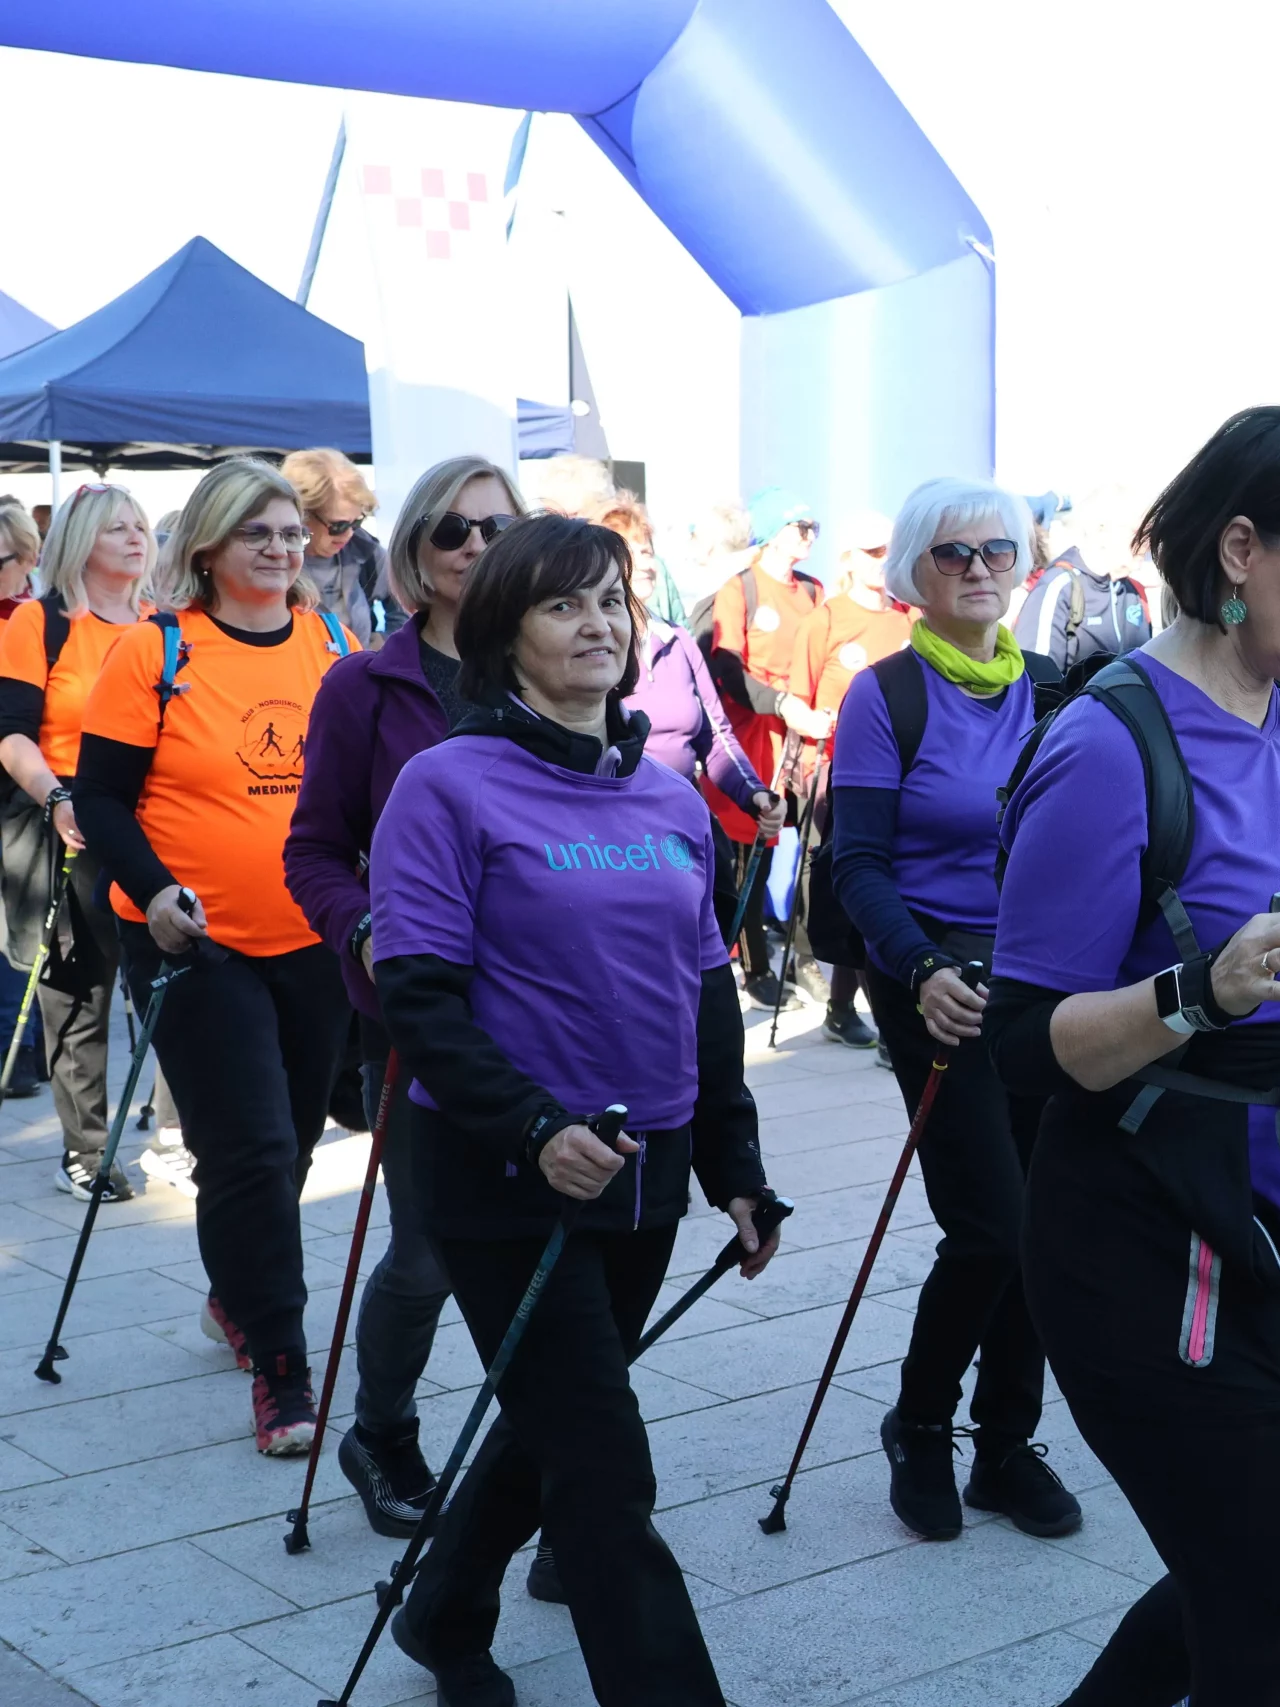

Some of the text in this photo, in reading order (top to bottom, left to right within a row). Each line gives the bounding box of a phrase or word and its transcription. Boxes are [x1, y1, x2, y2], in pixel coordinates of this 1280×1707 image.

[240, 708, 254, 724] KLUB
[248, 784, 302, 796] MEDIM
[543, 833, 661, 871] unicef
[375, 1083, 391, 1130] NEWFEEL
[516, 1269, 547, 1320] NEWFEEL
